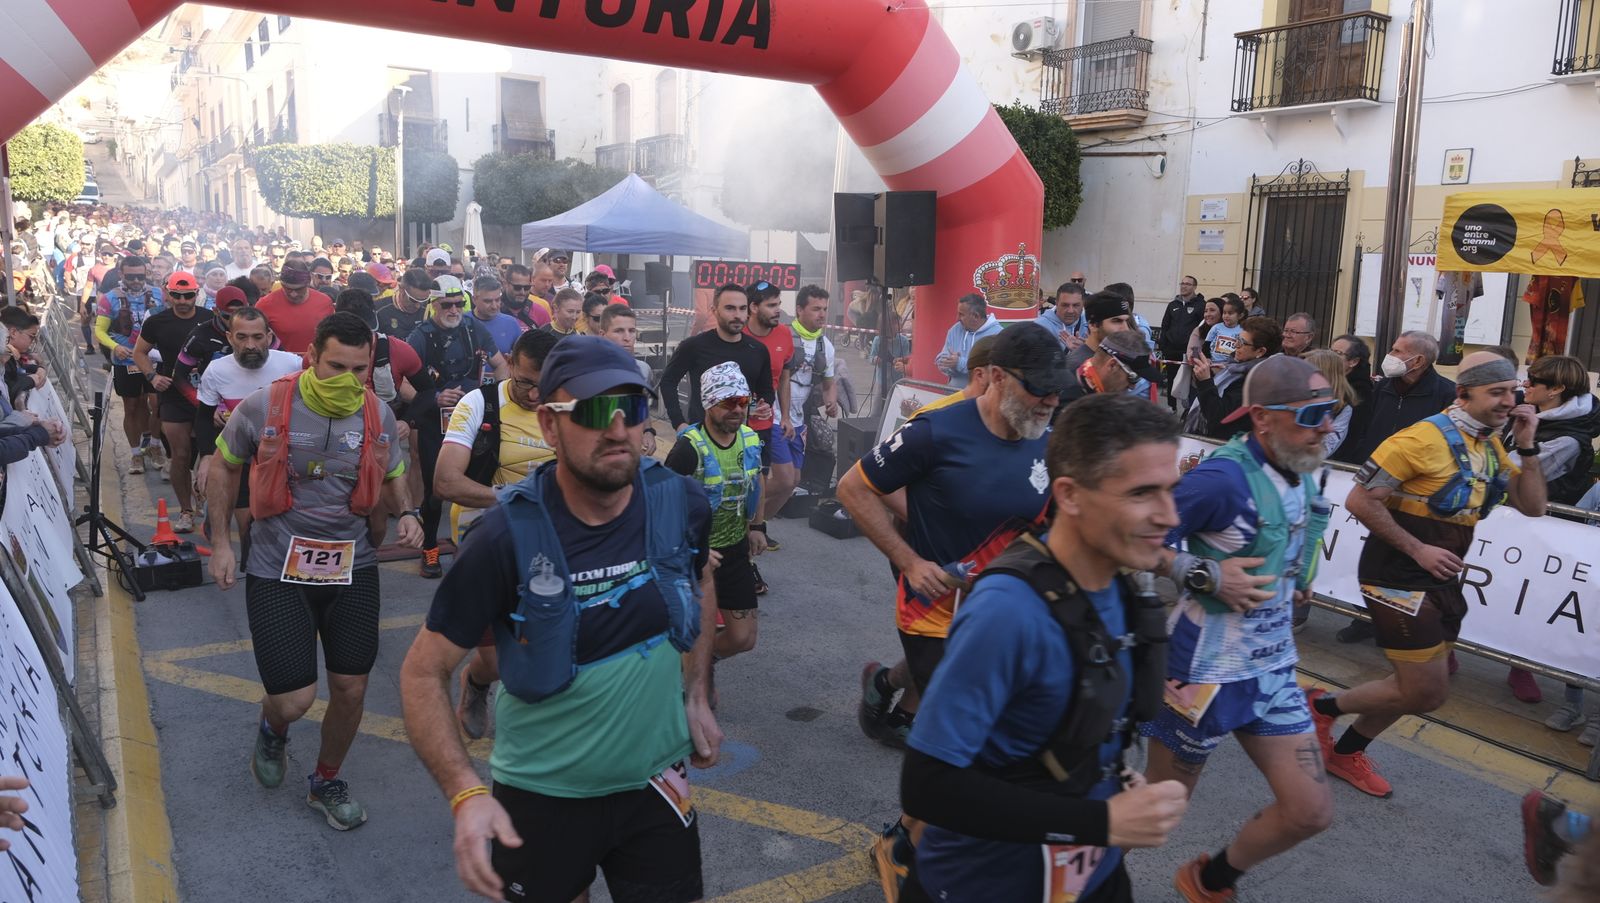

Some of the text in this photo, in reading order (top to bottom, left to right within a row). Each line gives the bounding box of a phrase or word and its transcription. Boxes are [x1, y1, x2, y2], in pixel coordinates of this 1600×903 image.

[1463, 231, 1489, 239] entre
[1462, 238, 1496, 246] cienmil
[1460, 245, 1478, 254] .org
[302, 549, 343, 566] 121
[1543, 554, 1592, 583] DE
